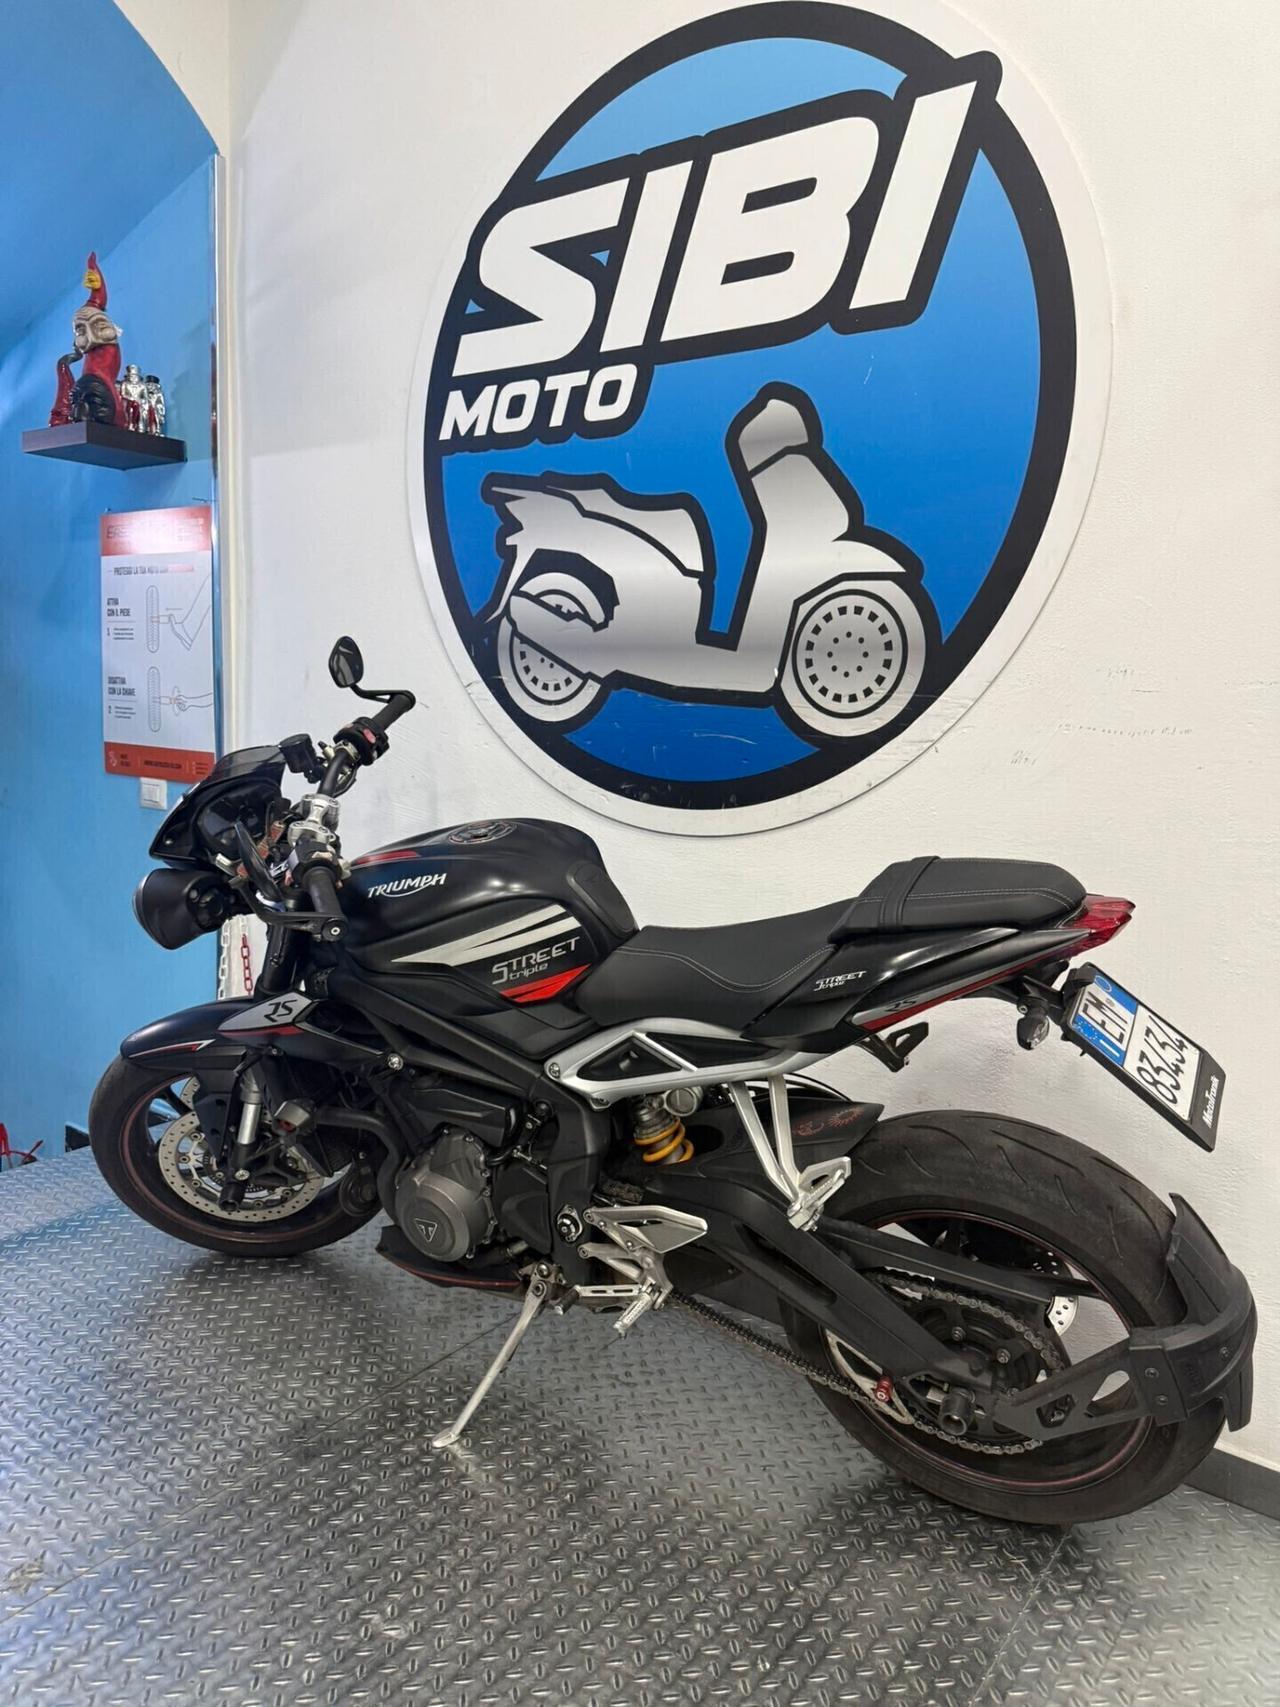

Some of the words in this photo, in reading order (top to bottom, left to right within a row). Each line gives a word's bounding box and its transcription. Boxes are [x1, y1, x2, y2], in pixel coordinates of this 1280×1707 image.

[451, 80, 978, 378] SIBI
[438, 362, 639, 441] MOTO
[367, 872, 448, 899] TRIUMPH
[491, 936, 580, 985] STREET
[508, 962, 549, 981] triple
[813, 971, 867, 991] STREET
[1082, 990, 1128, 1045] EM
[1135, 1014, 1189, 1105] 83434
